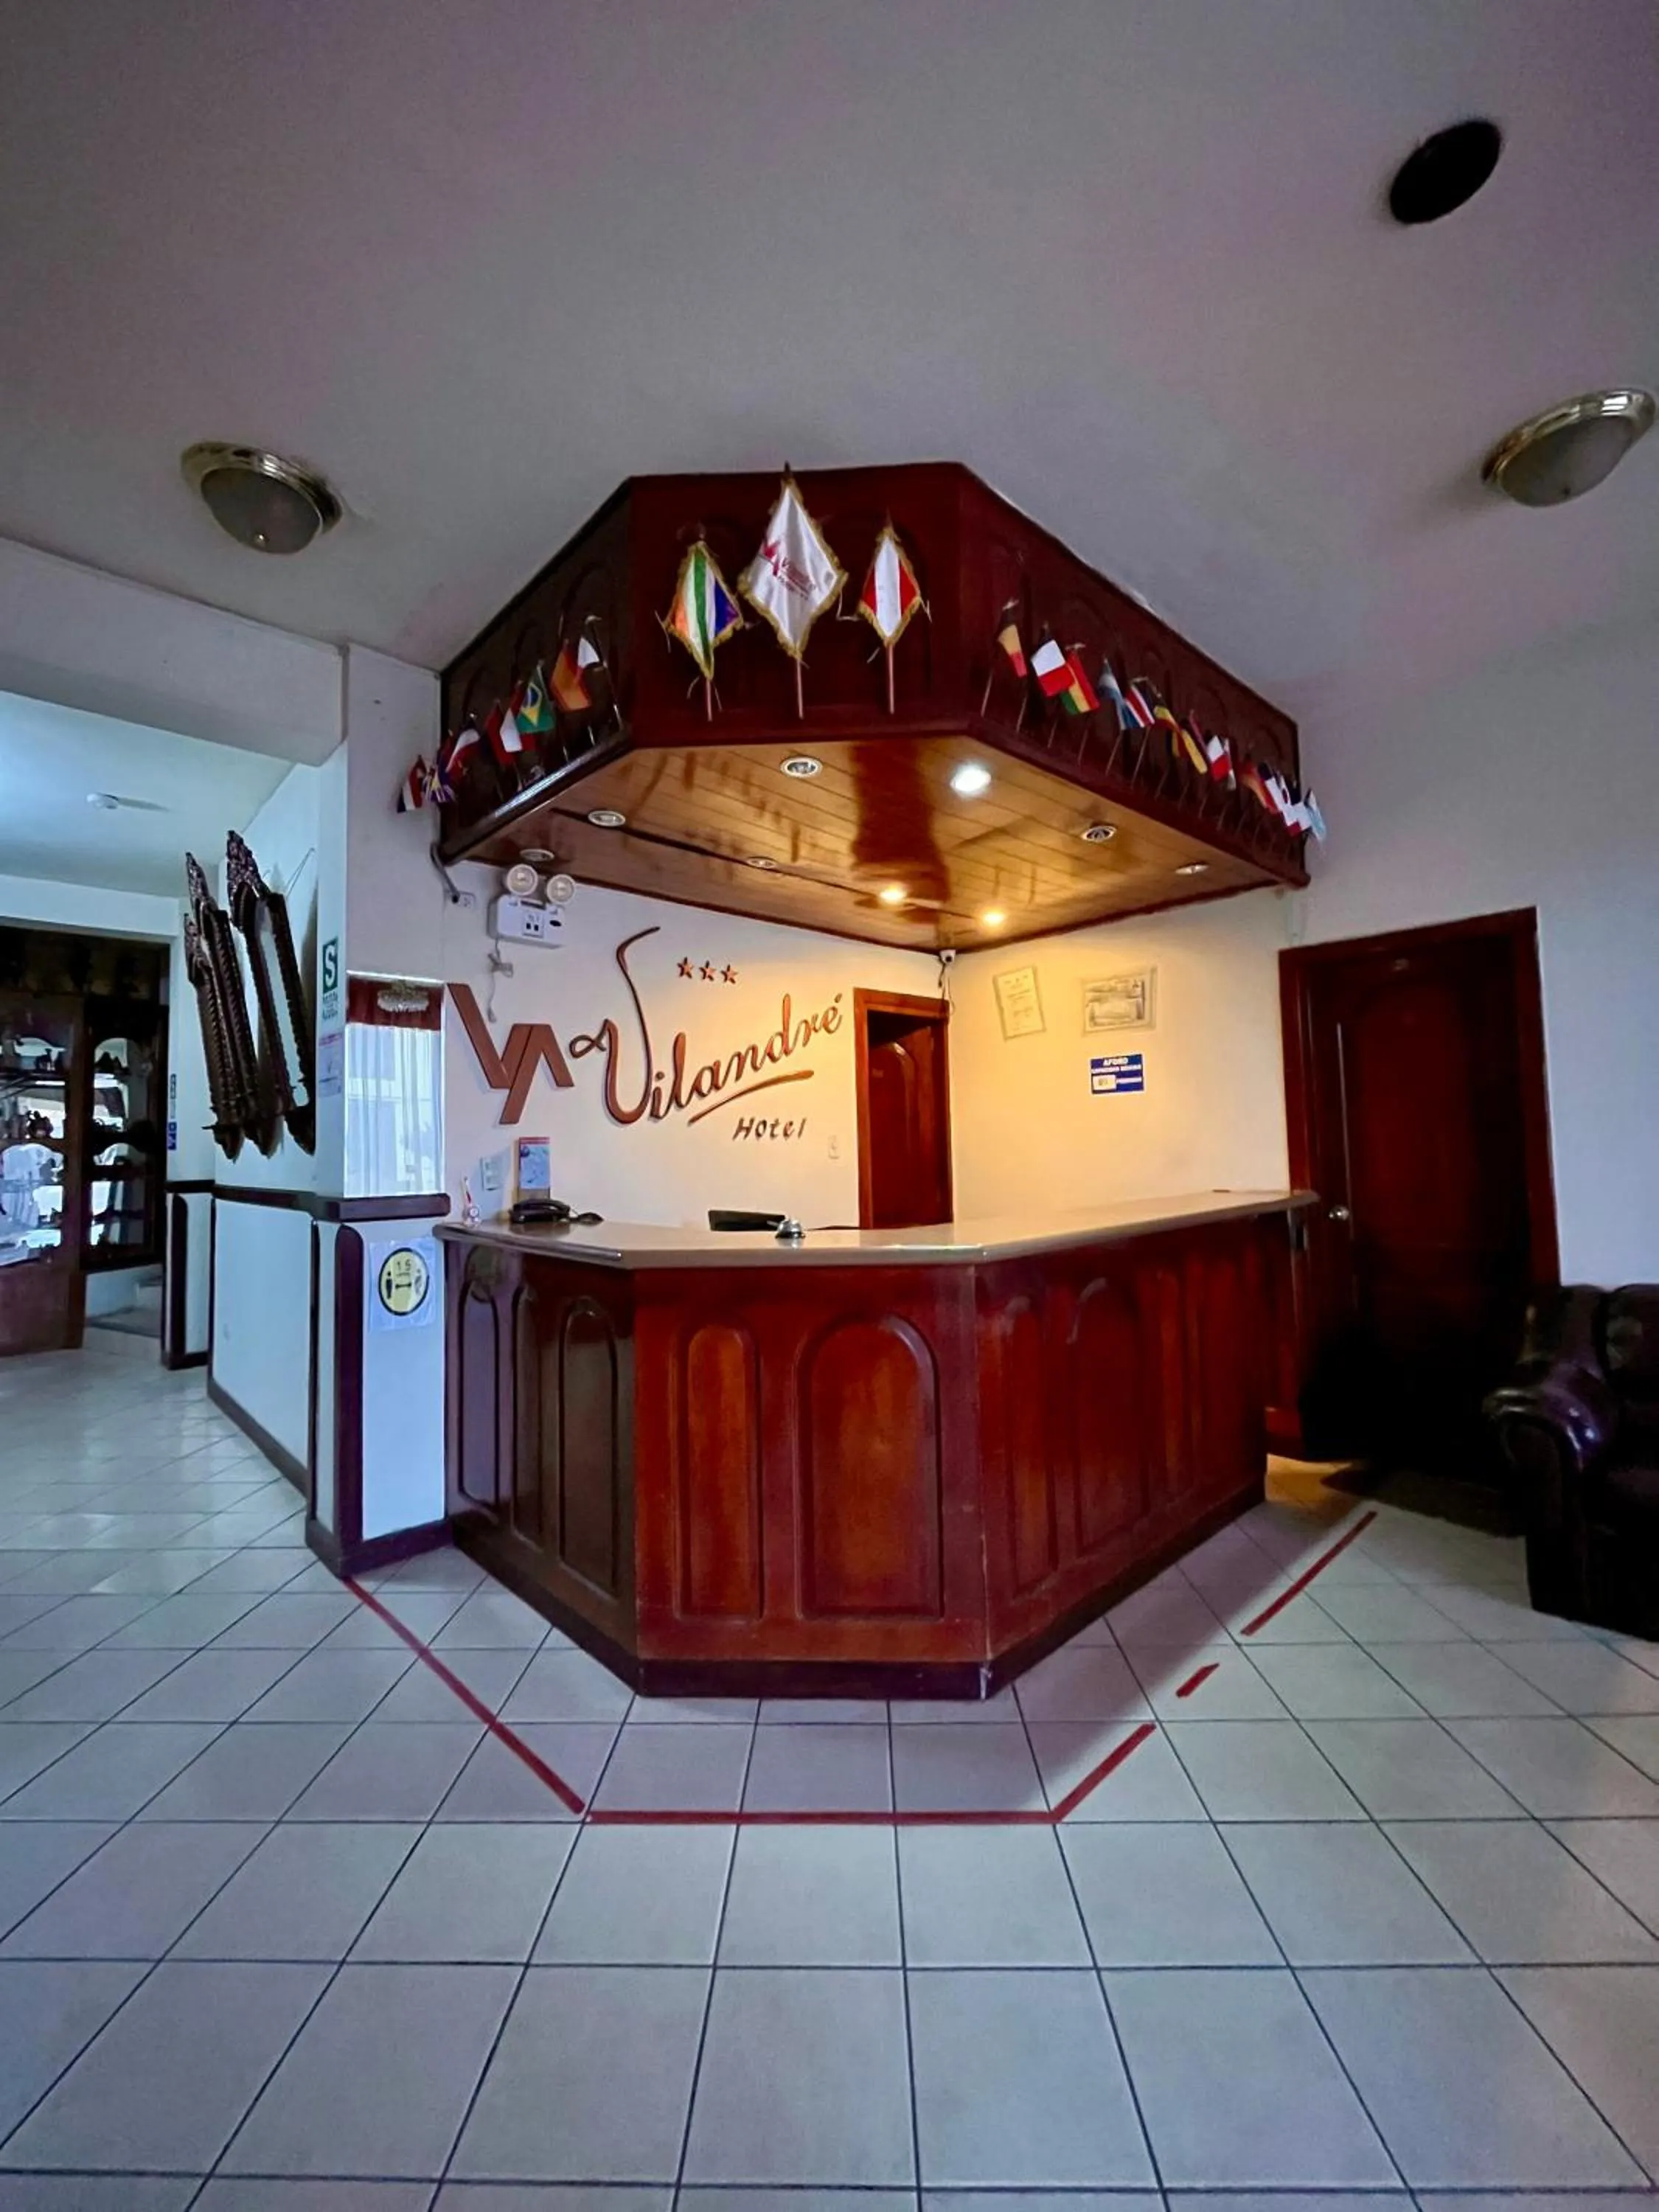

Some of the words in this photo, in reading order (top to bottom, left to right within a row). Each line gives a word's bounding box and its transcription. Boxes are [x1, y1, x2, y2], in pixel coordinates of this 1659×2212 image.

[325, 945, 335, 988] S
[569, 926, 844, 1124] Vilandré
[731, 1116, 808, 1141] Hotel
